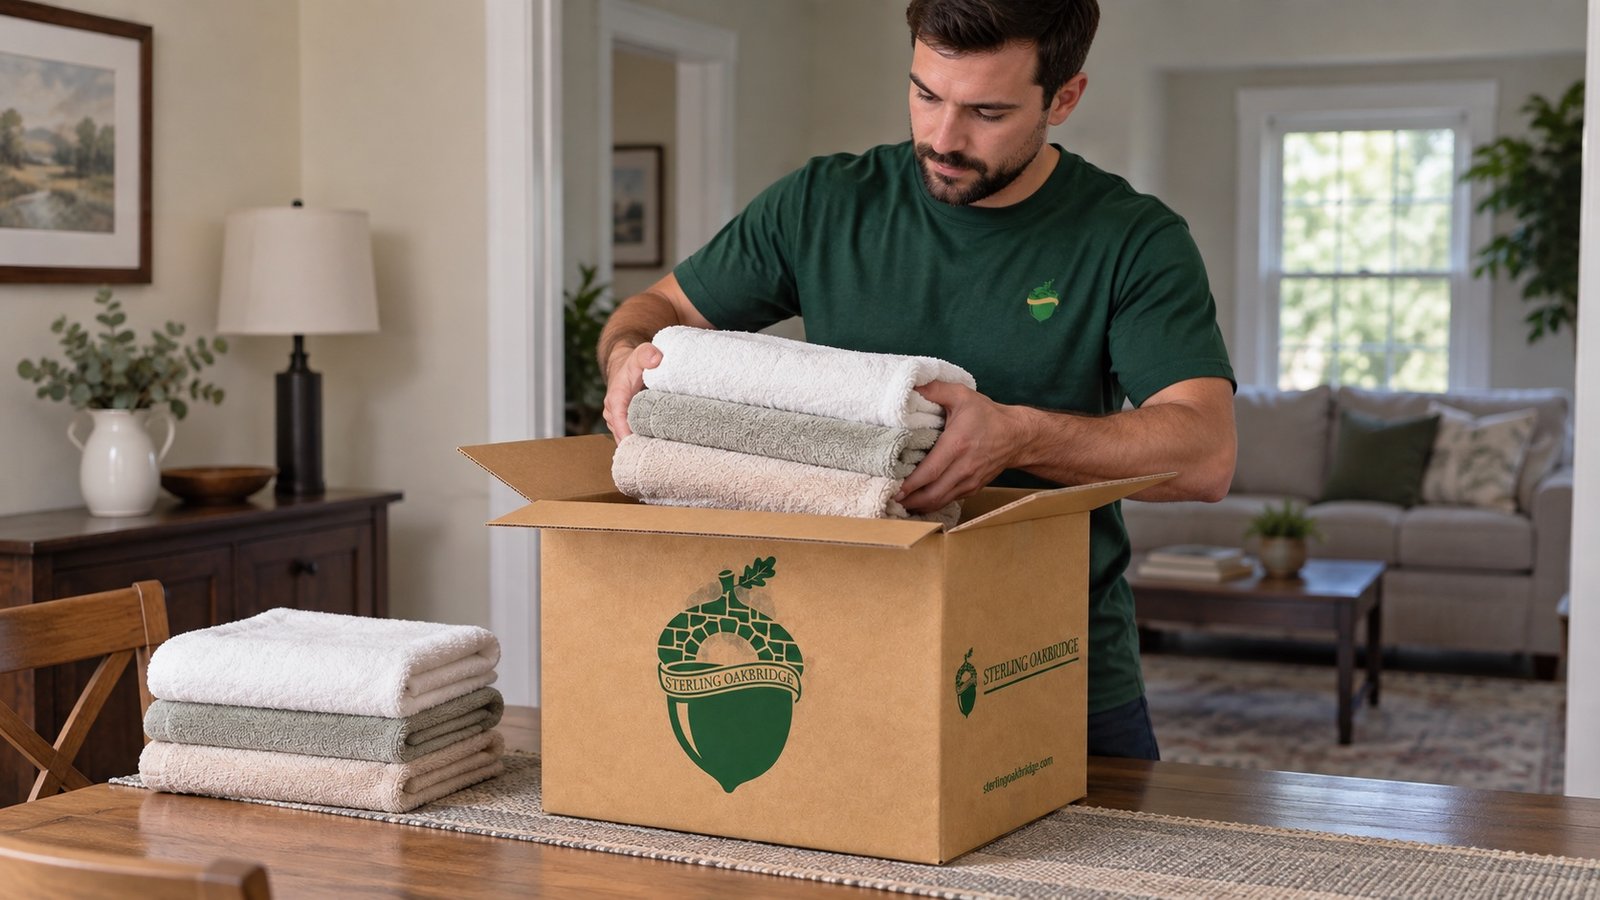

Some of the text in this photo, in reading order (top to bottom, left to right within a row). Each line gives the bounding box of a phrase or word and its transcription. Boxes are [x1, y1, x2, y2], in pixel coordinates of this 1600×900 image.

[665, 668, 794, 691] STERLING OAKBRIDGE
[983, 637, 1079, 685] STERLING OAKBRIDGE
[982, 756, 1054, 794] sterlingoakbridge.com
